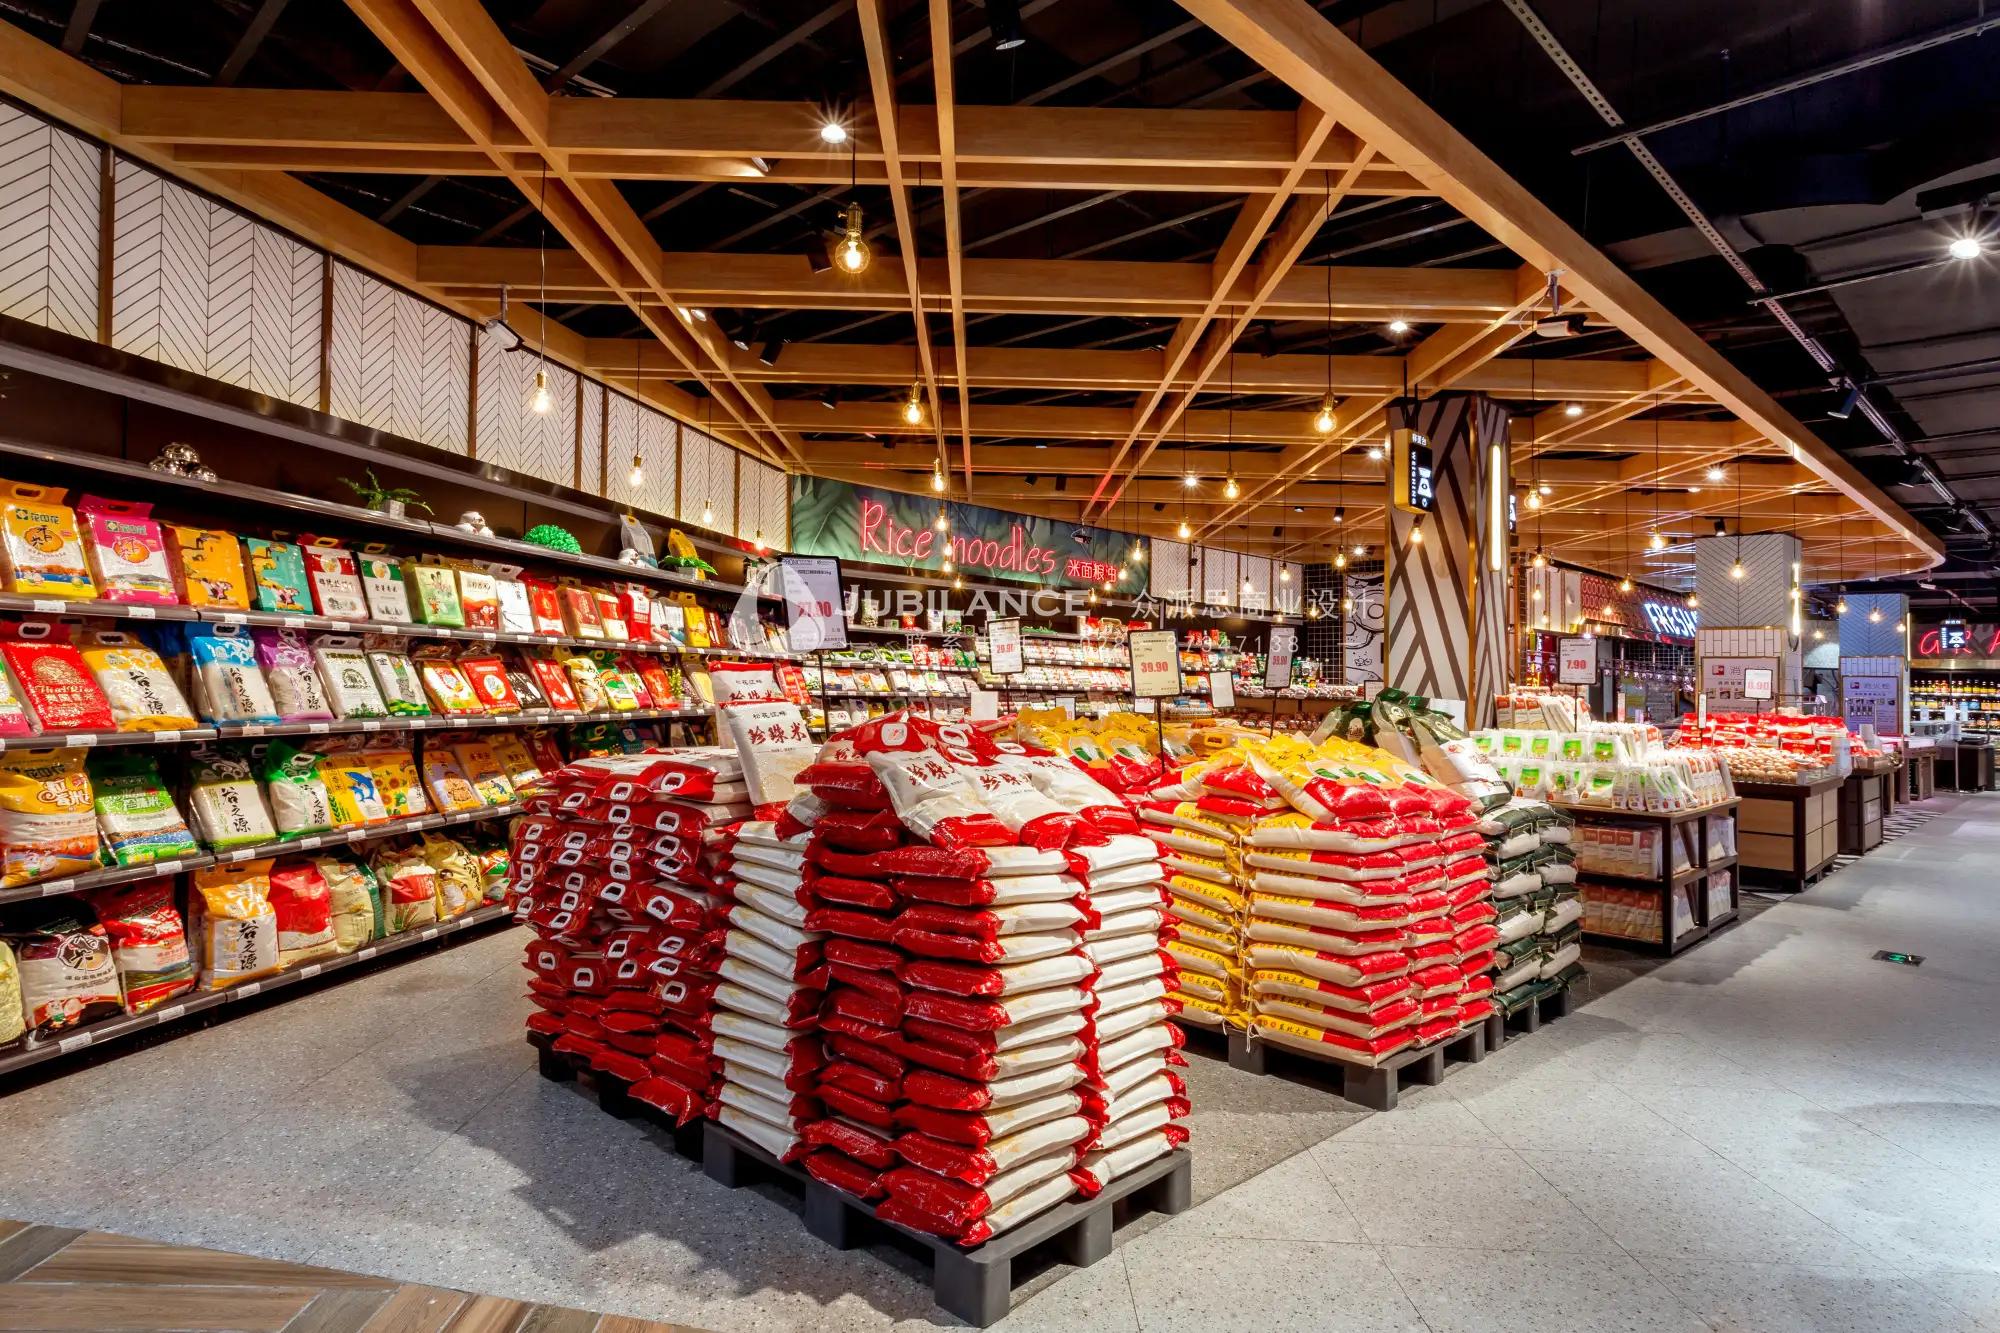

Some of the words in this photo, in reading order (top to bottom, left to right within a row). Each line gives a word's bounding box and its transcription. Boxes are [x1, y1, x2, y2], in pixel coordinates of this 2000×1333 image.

[862, 498, 934, 560] Rice
[952, 523, 1057, 575] noodles
[1067, 559, 1118, 583] 米面粮油
[1140, 660, 1169, 673] 39.90
[1566, 659, 1587, 670] 7.90
[747, 721, 808, 746] 珍珠米
[220, 785, 252, 834] 谷之源
[237, 919, 259, 970] 谷之源
